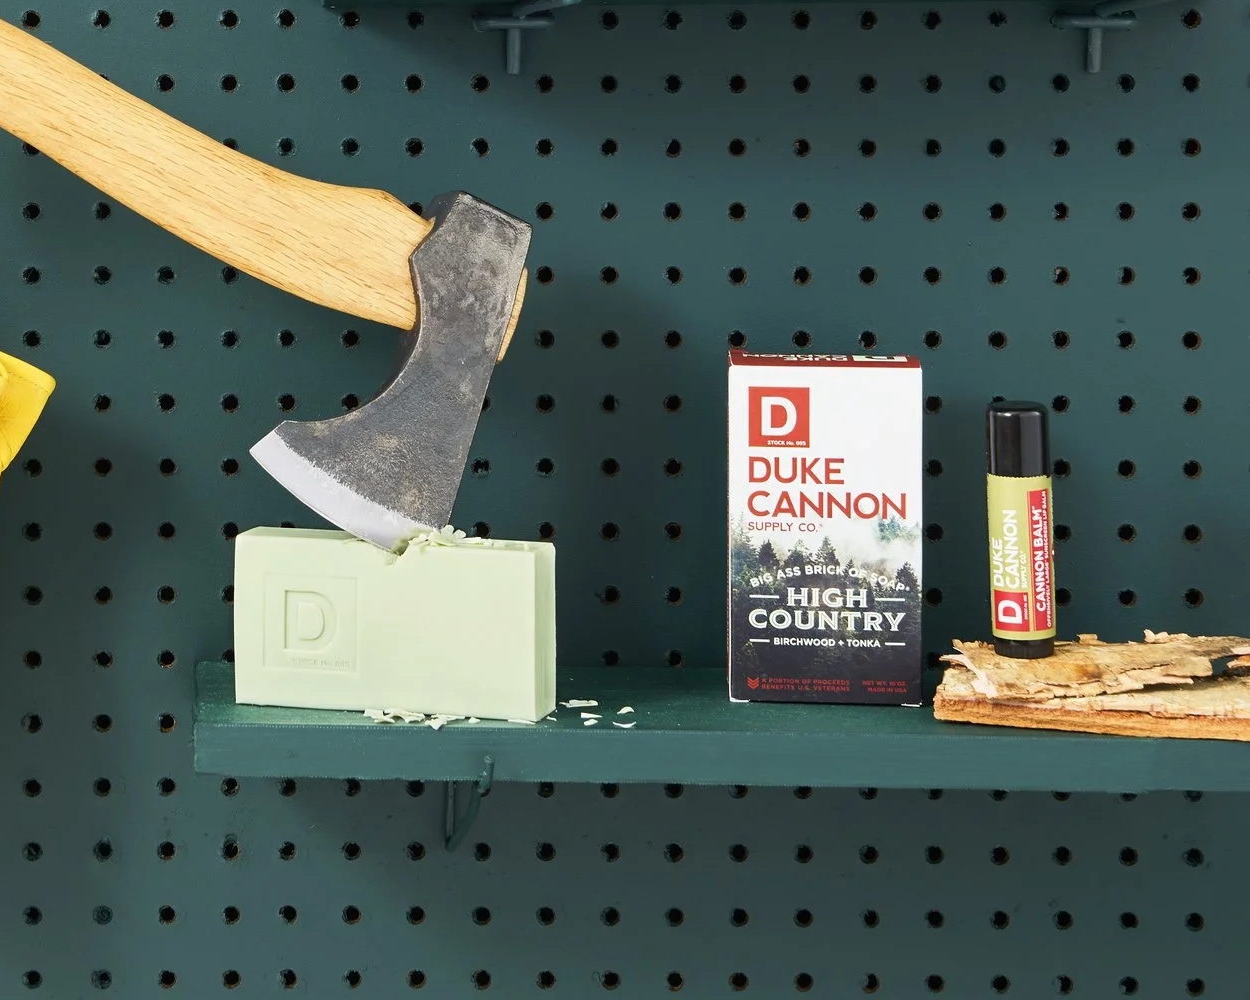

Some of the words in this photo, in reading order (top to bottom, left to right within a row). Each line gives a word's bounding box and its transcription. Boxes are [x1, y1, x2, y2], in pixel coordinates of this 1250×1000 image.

[761, 396, 797, 436] D
[749, 456, 844, 484] DUKE
[747, 490, 906, 519] CANNON
[748, 522, 793, 532] SUPPLY
[992, 538, 1004, 587] DUKE
[1003, 509, 1020, 589] CANNON
[750, 573, 773, 588] BIG
[777, 566, 801, 579] ASS
[805, 565, 845, 576] BRICK
[849, 568, 867, 579] OF
[871, 573, 906, 591] SOAP
[1033, 550, 1047, 612] CANNON
[786, 587, 868, 608] HIGH
[748, 609, 906, 631] COUNTRY
[998, 599, 1023, 624] D
[774, 637, 835, 647] BIRCHWOOD
[847, 639, 881, 647] TONKA
